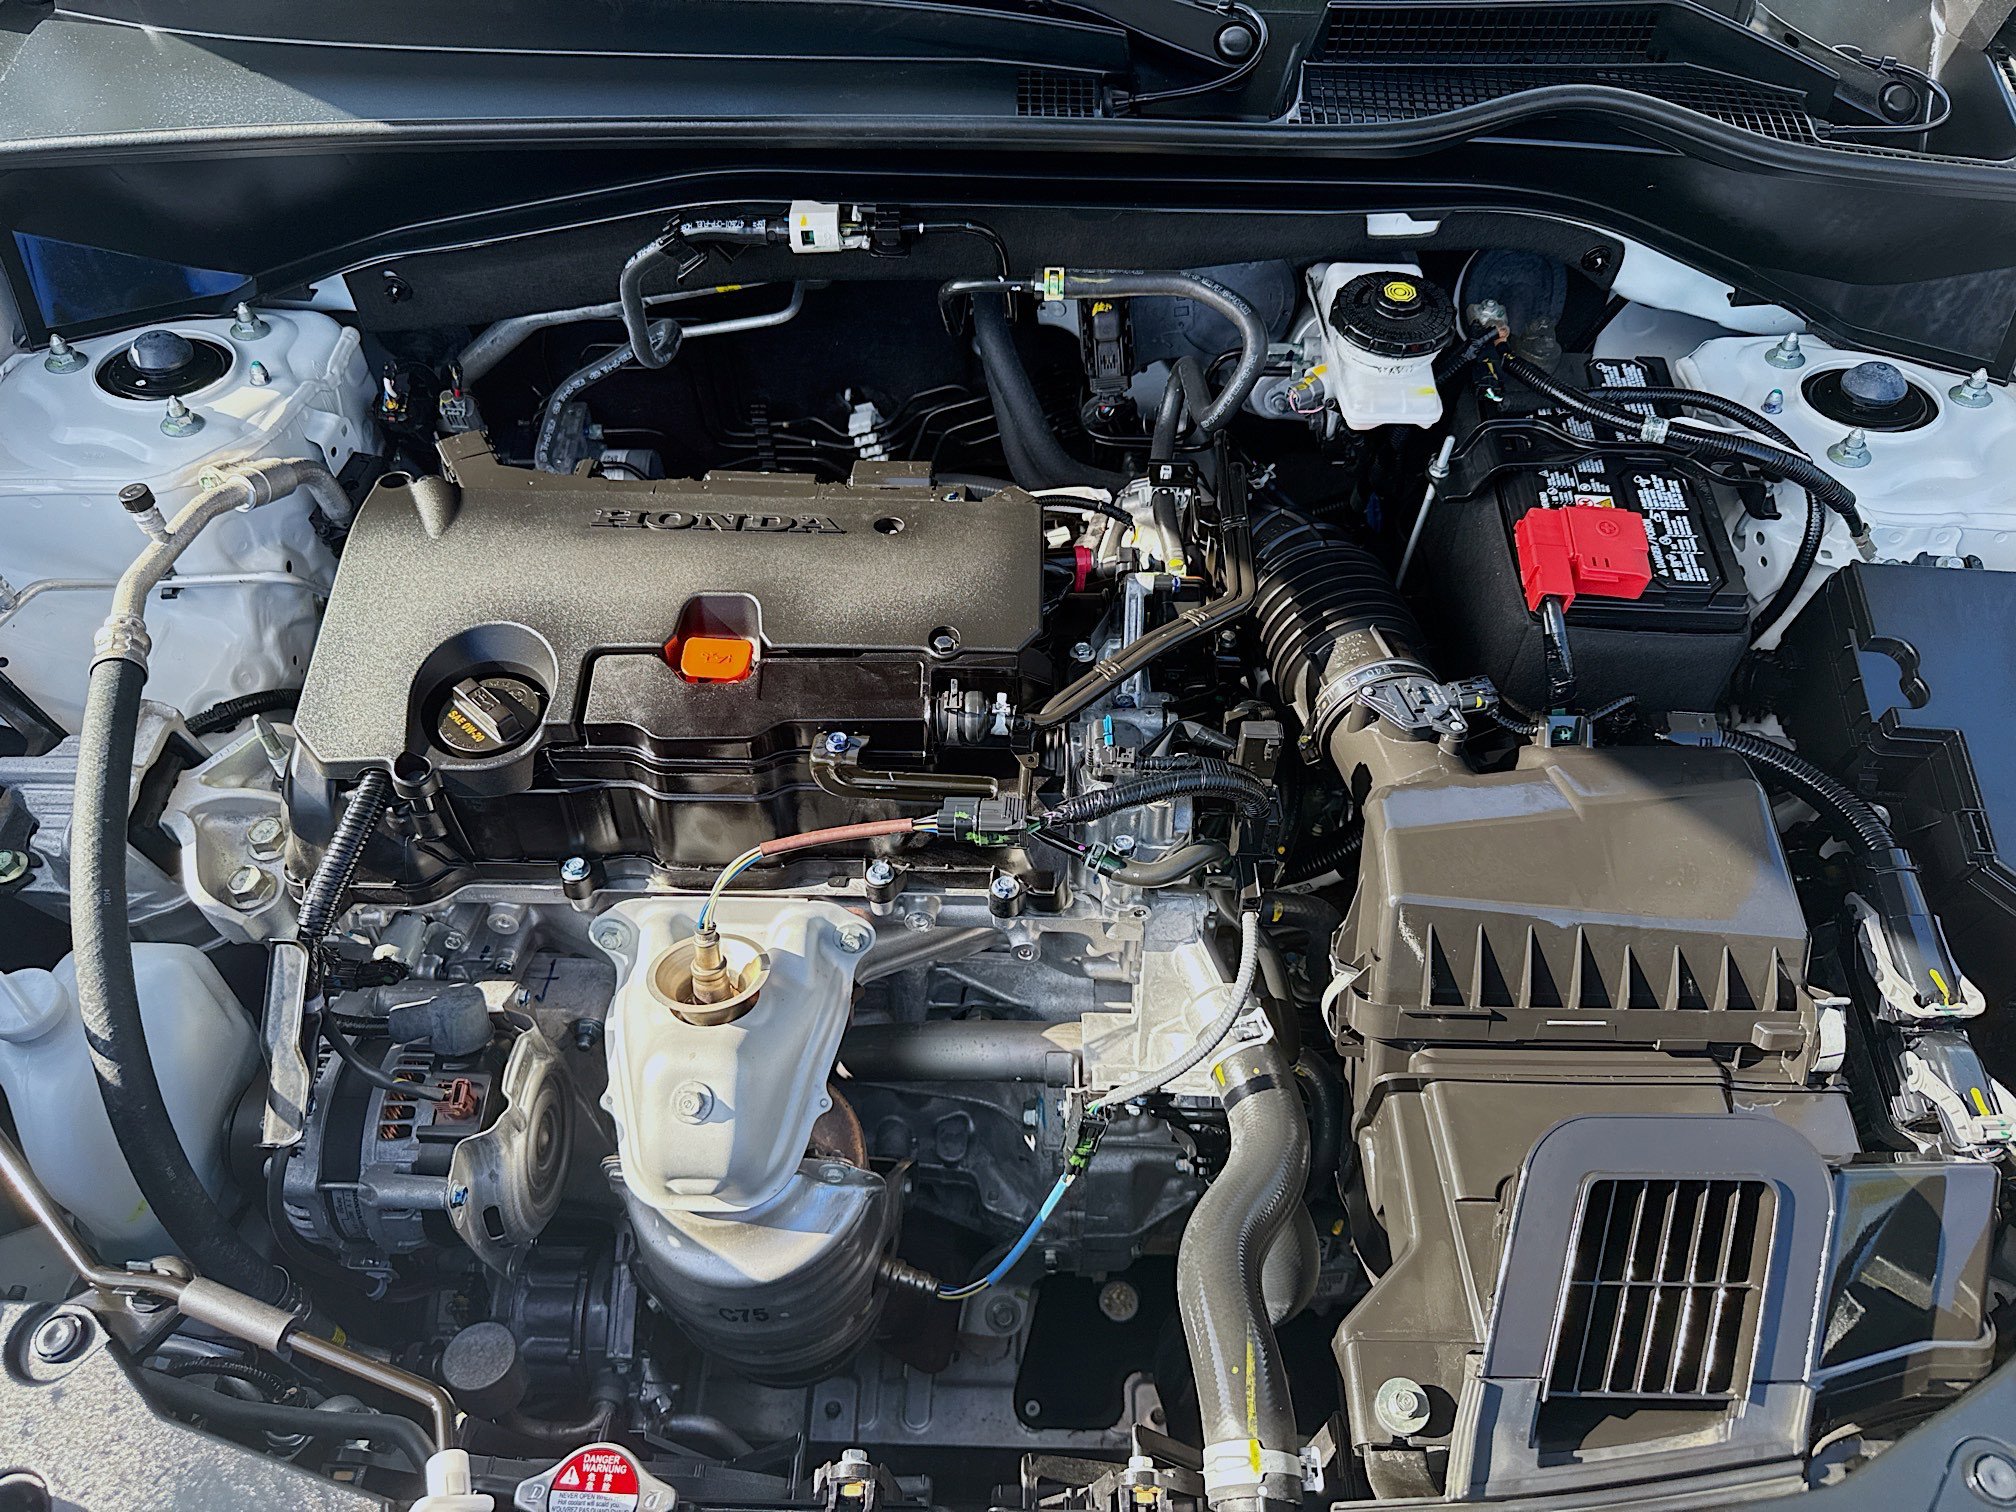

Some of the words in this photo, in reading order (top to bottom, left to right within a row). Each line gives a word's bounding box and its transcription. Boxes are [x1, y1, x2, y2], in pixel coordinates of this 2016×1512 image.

[590, 508, 848, 535] HONDA
[447, 710, 467, 726] SAE
[461, 722, 486, 743] 0W-20
[718, 1307, 770, 1323] C75
[583, 1454, 620, 1464] DANGER
[582, 1464, 627, 1474] WARNUNG
